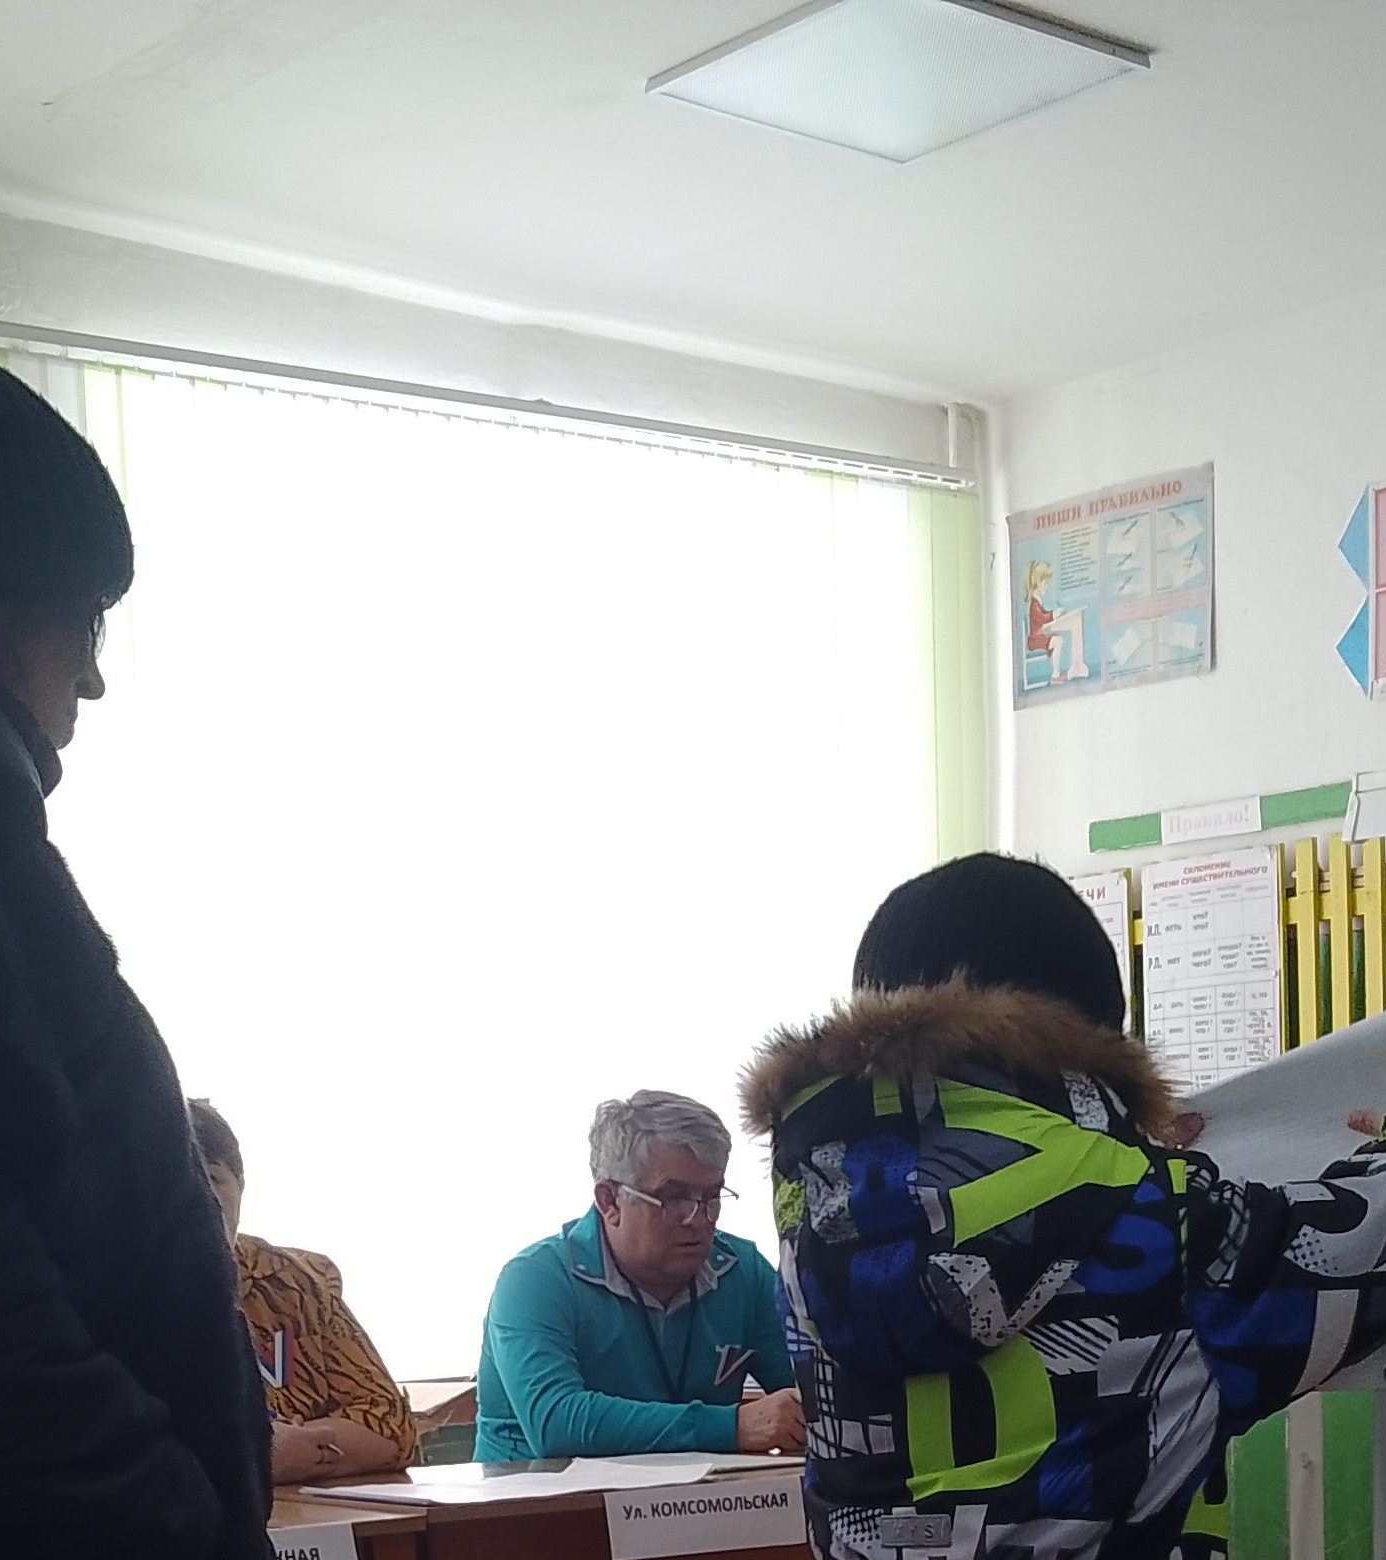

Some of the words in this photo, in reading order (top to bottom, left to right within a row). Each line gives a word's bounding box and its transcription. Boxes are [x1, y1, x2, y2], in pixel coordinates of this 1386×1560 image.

[1088, 479, 1182, 517] ПРАВИЛЬНО
[1169, 804, 1249, 835] Правило!
[623, 1505, 647, 1520] Ул.
[651, 1492, 789, 1518] КОМСОМОЛЬСКАЯ
